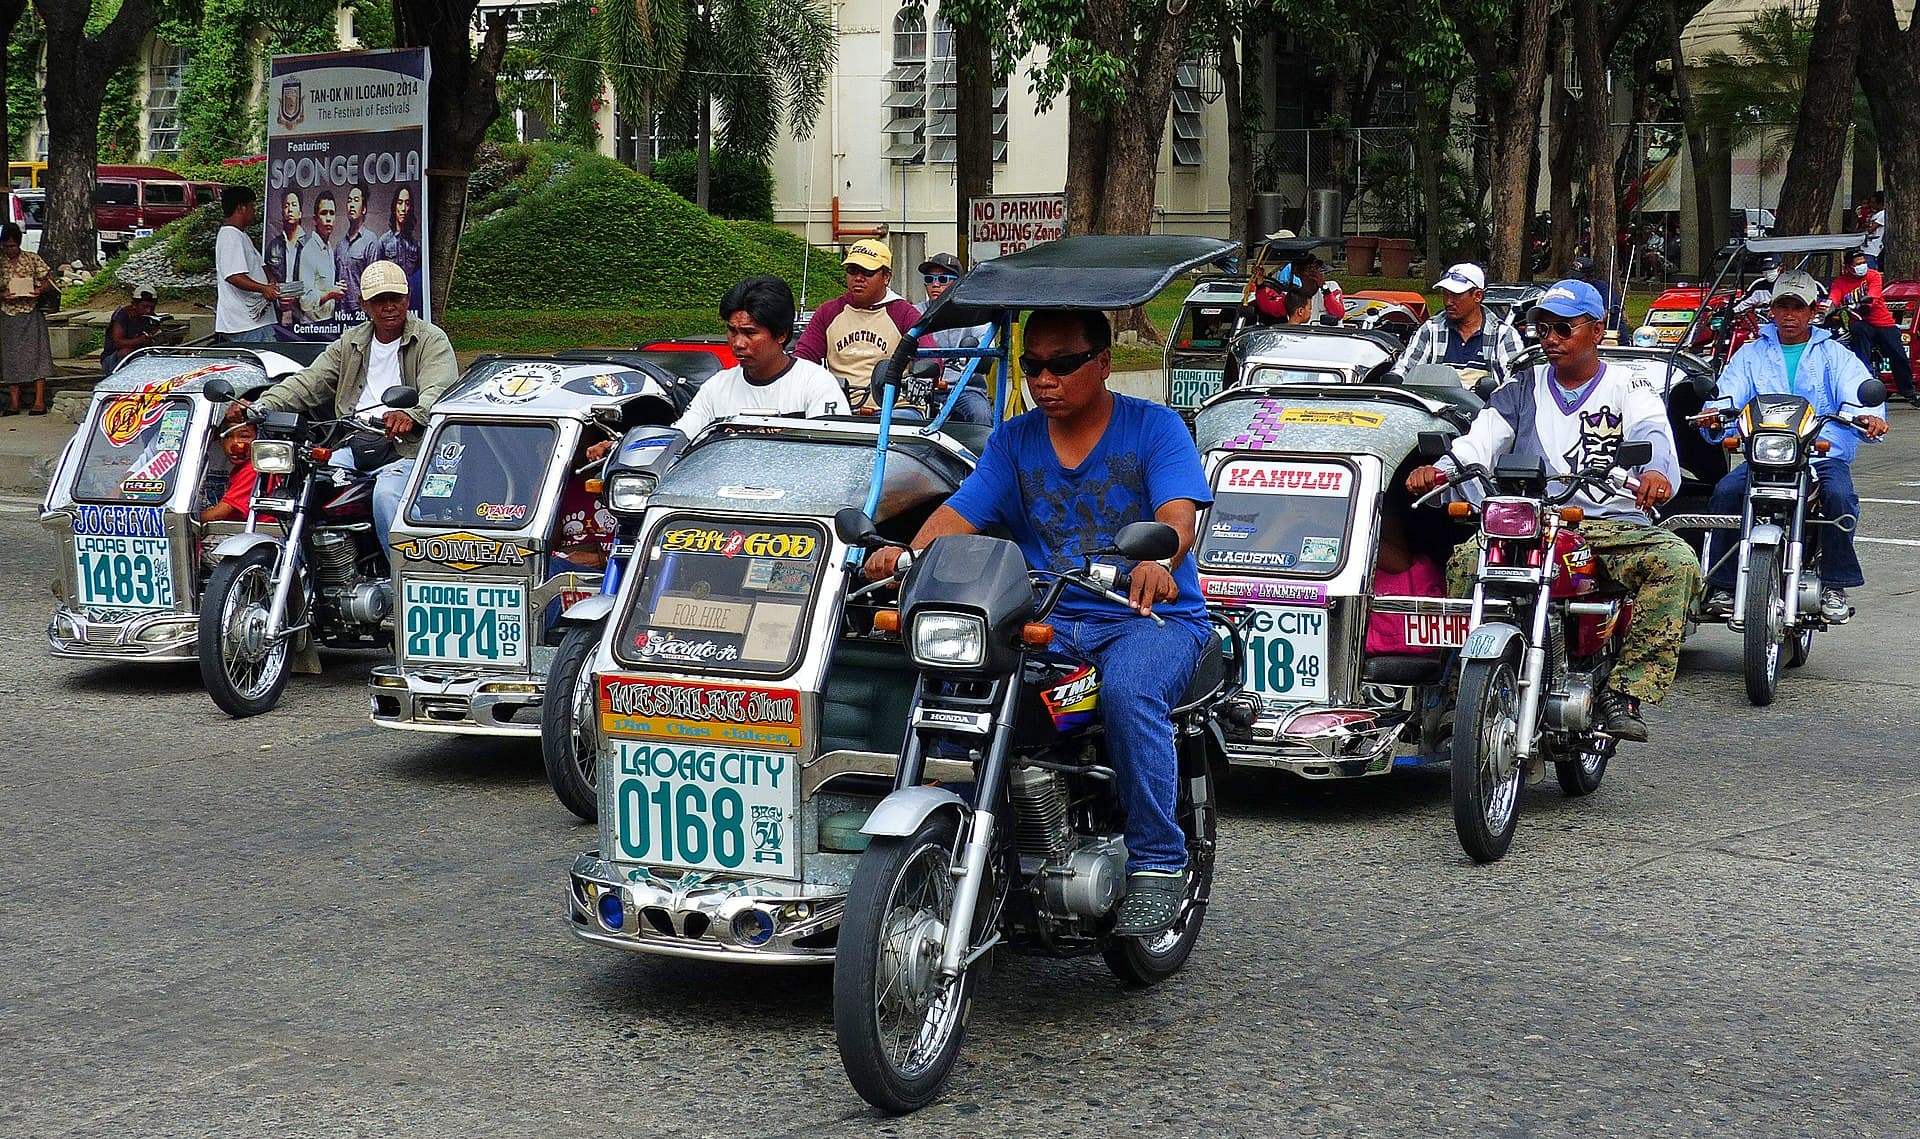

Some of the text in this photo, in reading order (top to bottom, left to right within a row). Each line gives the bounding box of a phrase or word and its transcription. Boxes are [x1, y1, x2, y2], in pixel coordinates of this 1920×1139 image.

[310, 80, 418, 104] TAN-OK NI ILOCANO 2014
[318, 102, 410, 120] The Festival of Festivals
[287, 140, 330, 153] Featuring:
[270, 150, 420, 189] SPONGE COLA
[973, 200, 1063, 222] NO PARKING
[973, 222, 1062, 243] LOADING Zone
[334, 311, 354, 321] Nov.
[293, 323, 341, 334] Centennial
[1173, 370, 1224, 381] LAOAG CITY
[1228, 468, 1343, 491] KAHULUI
[74, 504, 166, 537] JOCELYN
[77, 537, 167, 555] LAOAG CITY
[405, 538, 525, 565] JOMEA
[662, 528, 727, 552] Gift
[743, 532, 816, 558] GOD
[79, 552, 155, 604] 1483
[154, 577, 172, 605] 12
[407, 584, 520, 608] LAOAG CITY
[672, 603, 731, 630] FOR HIRE
[1277, 612, 1322, 635] CITY
[407, 605, 499, 660] 2774
[499, 622, 521, 642] 38
[1406, 614, 1470, 645] FOR HIR
[502, 642, 517, 657] B
[1296, 654, 1319, 677] 48
[1053, 672, 1097, 701] TMX
[1061, 694, 1084, 707] 155
[930, 713, 970, 723] HONDA
[620, 744, 785, 789] LAOAG CITY
[618, 778, 746, 869] 0168
[755, 821, 782, 849] 54
